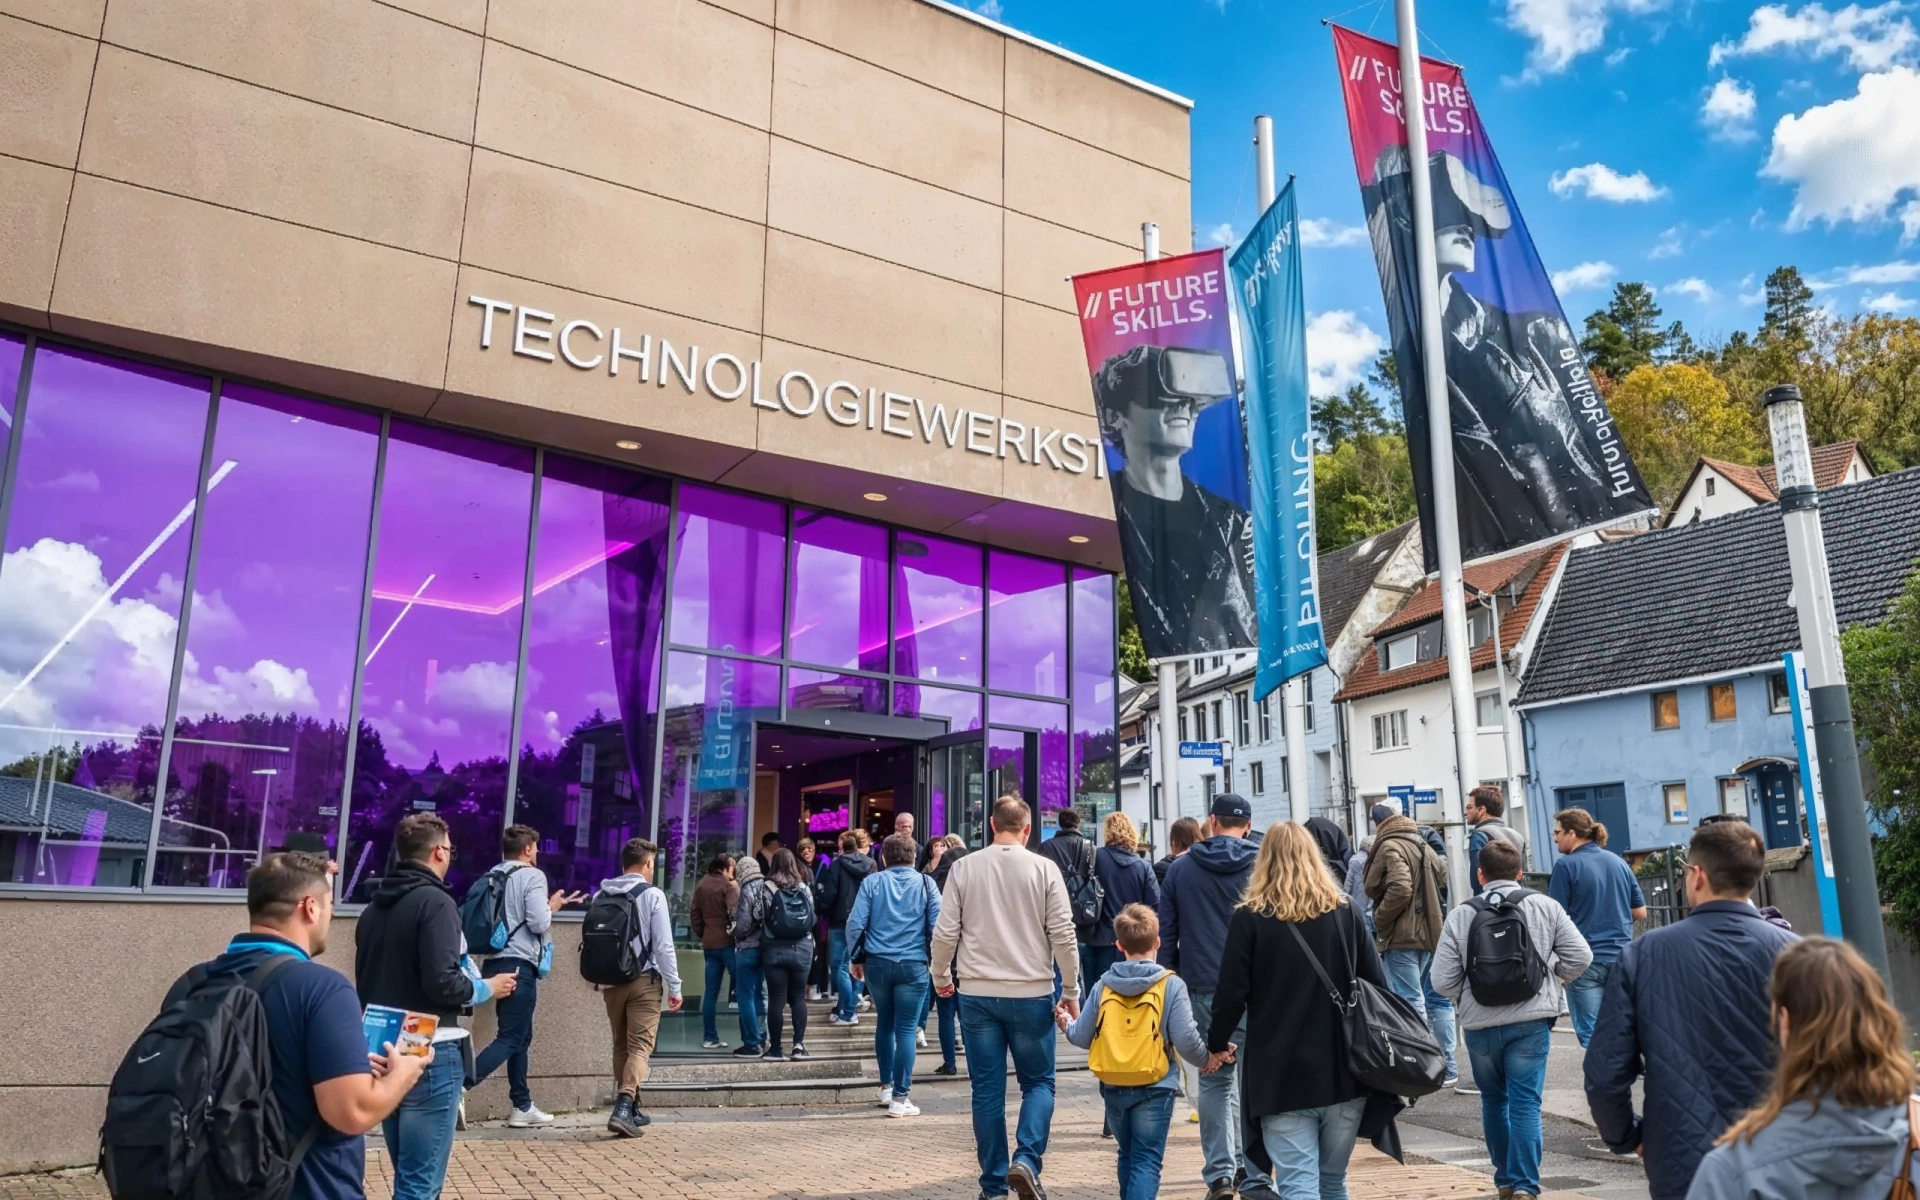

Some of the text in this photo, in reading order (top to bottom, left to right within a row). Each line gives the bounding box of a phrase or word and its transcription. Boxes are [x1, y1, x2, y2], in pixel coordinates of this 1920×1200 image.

[1371, 58, 1469, 109] FUURE
[1108, 270, 1219, 311] FUTURE
[1112, 299, 1213, 335] SKILLS.
[468, 295, 1105, 479] TECHNOLOGIEWERKST
